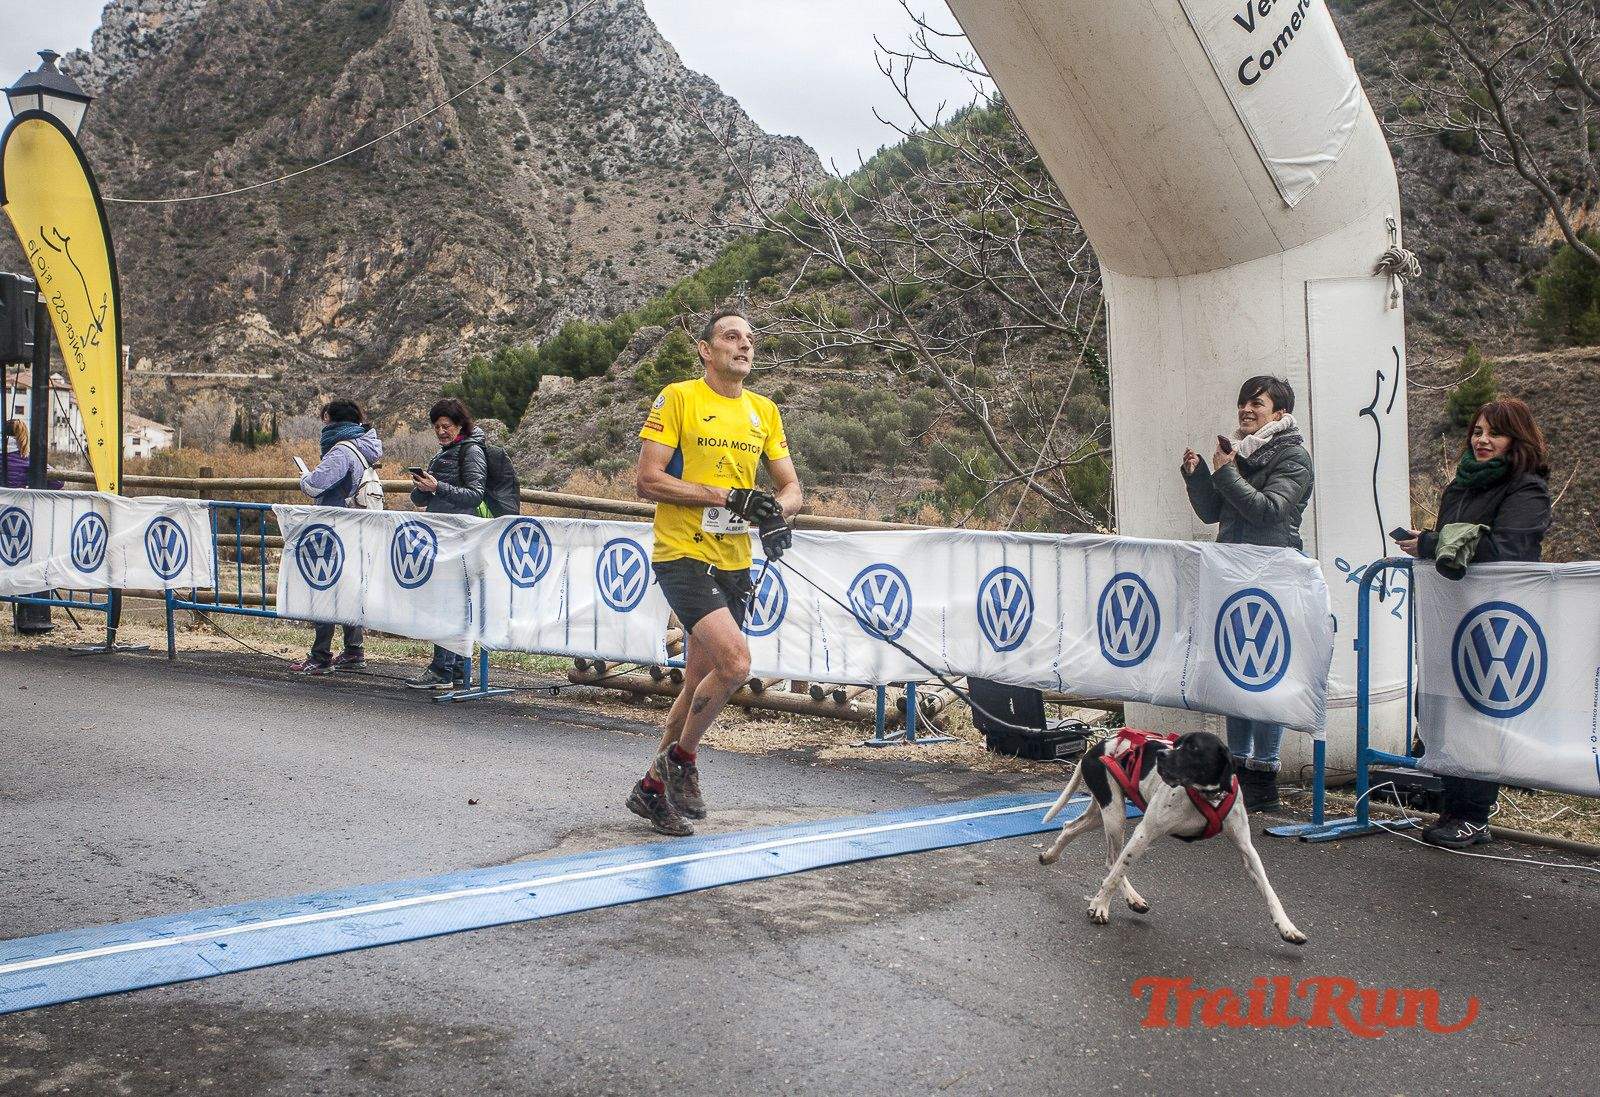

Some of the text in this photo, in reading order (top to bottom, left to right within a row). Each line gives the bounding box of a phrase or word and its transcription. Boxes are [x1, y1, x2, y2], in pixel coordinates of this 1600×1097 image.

[1232, 0, 1277, 33] Ve
[697, 436, 729, 448] RIOJA
[1220, 594, 1286, 686] VW
[1458, 609, 1541, 711] VW
